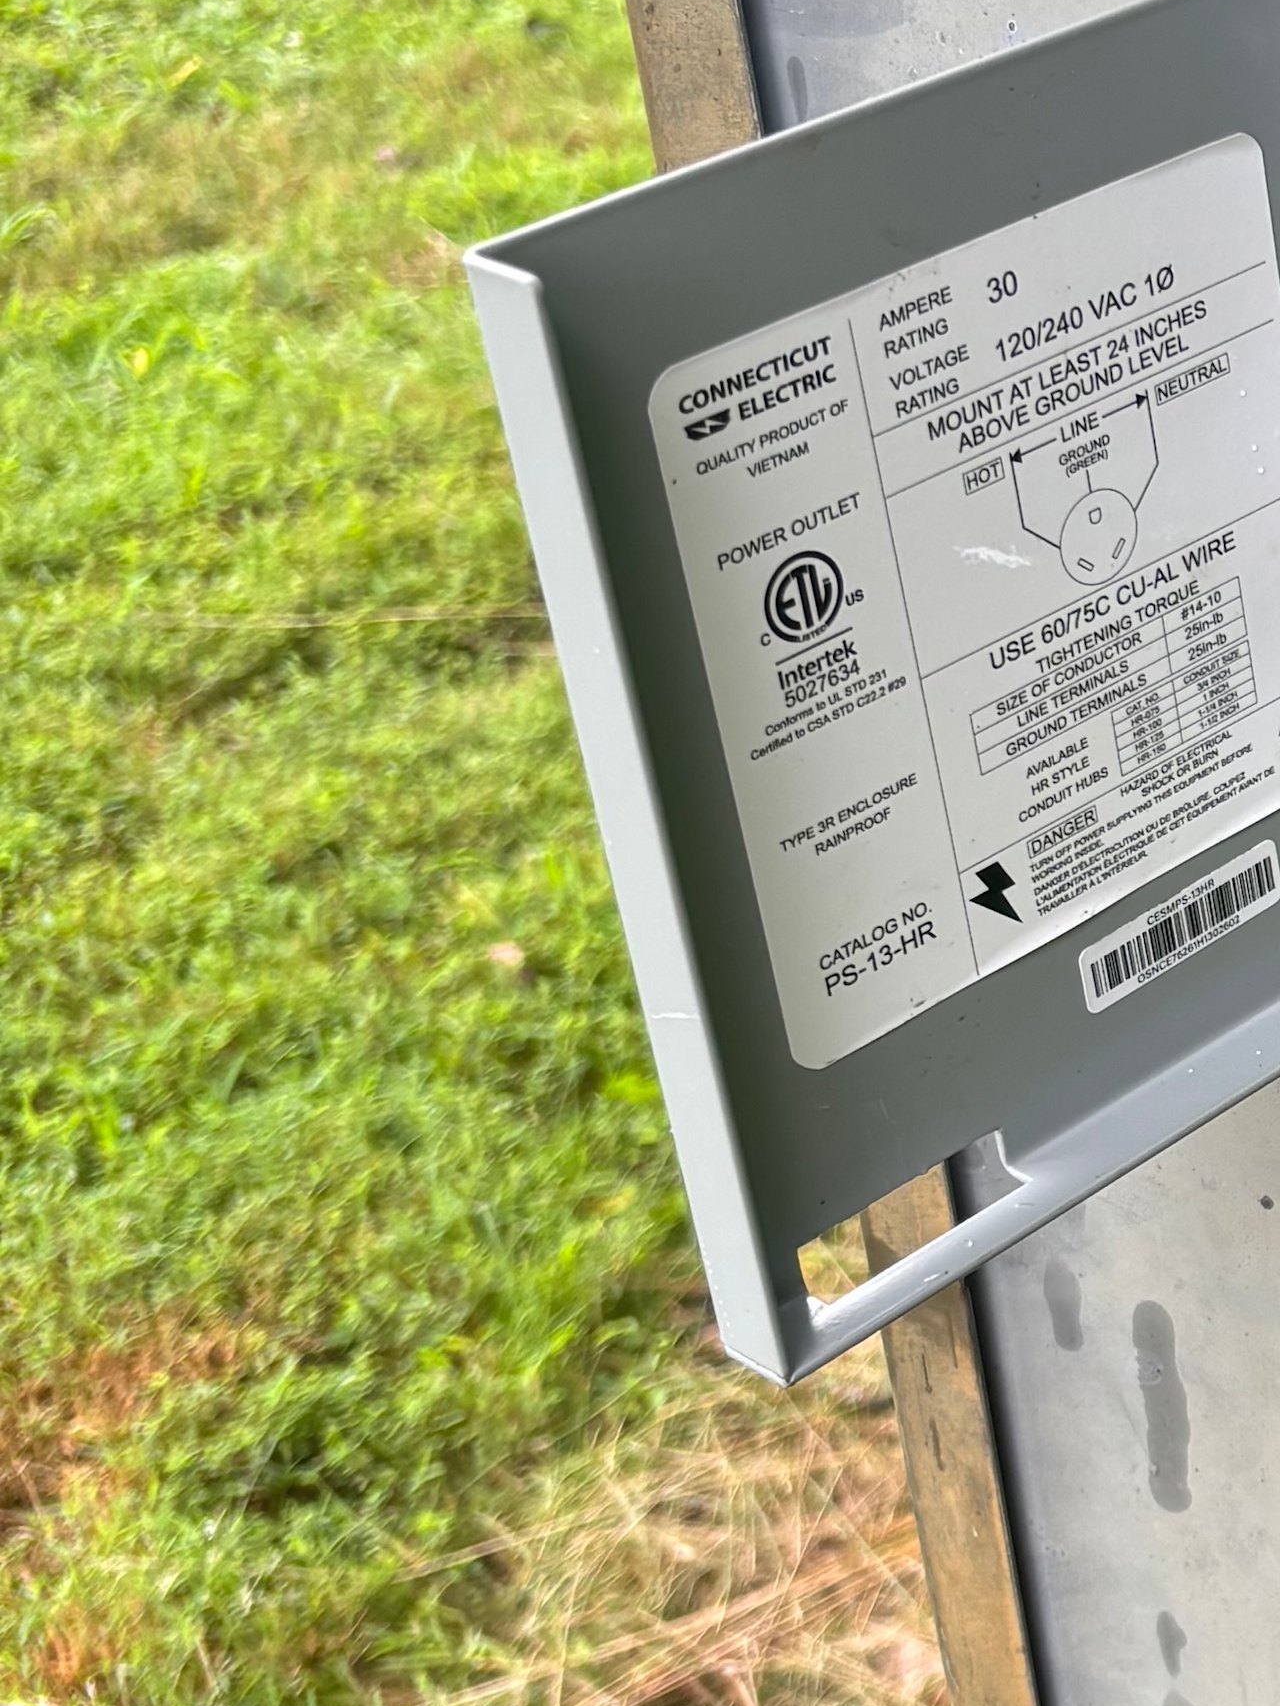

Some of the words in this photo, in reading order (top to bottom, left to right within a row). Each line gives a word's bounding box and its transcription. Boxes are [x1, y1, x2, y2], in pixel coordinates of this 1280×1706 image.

[879, 285, 952, 331] AMPERE
[986, 270, 1017, 303] 30
[883, 317, 948, 358] RATING
[995, 305, 1083, 361] 120/240
[1087, 282, 1136, 319] VAC
[678, 335, 830, 414] CONNECTICUT
[888, 343, 969, 390] VOLTAGE
[927, 388, 1003, 440] MOUNT
[1009, 375, 1032, 405] AT
[1038, 345, 1101, 390] LEAST
[1106, 334, 1129, 359] 24
[1134, 299, 1206, 347] INCHES
[1154, 357, 1227, 404] NEUTRAL
[737, 363, 836, 421] ELECTRIC
[895, 377, 959, 418] RATING
[958, 404, 1030, 453] ABOVE
[1034, 362, 1123, 415] GROUND
[1127, 334, 1189, 375] LEVEL
[695, 438, 755, 475] QUALITY
[758, 408, 825, 448] PRODUCT
[829, 398, 847, 416] OF
[1058, 434, 1110, 465] GROUND
[1059, 411, 1099, 442] LINE
[746, 441, 809, 477] VIETNAM
[966, 461, 999, 490] HOT
[1065, 448, 1108, 477] (GREEN)
[716, 526, 787, 571] POWER
[790, 491, 859, 536] OUTLET
[774, 563, 832, 641] ETL
[845, 588, 864, 606] US
[989, 631, 1036, 669] USE
[1040, 595, 1110, 643] 60/75C
[1116, 562, 1179, 605] CU-AL
[1181, 530, 1236, 571] WIRE
[760, 632, 771, 646] C
[1035, 614, 1132, 673] TIGHTENING
[1134, 579, 1199, 622] TORQUE
[777, 639, 857, 690] Intertek
[996, 689, 1028, 715] SIZE
[1031, 677, 1050, 697] OF
[1054, 631, 1142, 685] CONDUCTOR
[1180, 590, 1221, 620] #14-10
[1210, 667, 1230, 684] INCH
[764, 706, 814, 736] Conforms
[815, 700, 826, 711] to
[827, 692, 842, 705] UL
[844, 678, 866, 696] STD
[868, 668, 886, 685] 231
[784, 658, 860, 708] 5027634
[1016, 701, 1048, 727] LINE
[1050, 659, 1128, 708] TERMINALS
[1208, 681, 1229, 698] INCH
[1217, 690, 1238, 706] INCH
[750, 732, 793, 760] Certified
[794, 728, 805, 739] to
[806, 714, 831, 732] CSA
[831, 702, 854, 720] STD
[1005, 715, 1067, 755] GROUND
[1069, 673, 1146, 721] TERMINALS
[1219, 702, 1239, 718] INCH
[1026, 736, 1088, 778] AVAILABLE
[1031, 777, 1049, 795] HR
[1051, 755, 1089, 784] STYLE
[1119, 769, 1159, 797] HAZARD
[1160, 759, 1174, 774] OF
[1175, 730, 1232, 766] ELECTRICAL
[1140, 772, 1175, 796] SHOCK
[1176, 763, 1191, 777] OR
[1191, 747, 1218, 769] BURN
[778, 825, 815, 851] TYPE
[817, 816, 835, 833] 3R
[837, 772, 917, 823] ENCLOSURE
[1018, 784, 1072, 822] CONDUIT
[1075, 766, 1108, 792] HUBS
[1029, 854, 1054, 872] TURN
[1054, 843, 1072, 858] OFF
[1073, 825, 1105, 848] POWER
[1106, 799, 1152, 830] SUPPLYING
[1153, 787, 1172, 803] THIS
[1220, 743, 1252, 767] BEFORE
[1155, 826, 1168, 838] DE
[1238, 772, 1262, 792] AVANT
[1263, 765, 1275, 777] DE
[814, 806, 890, 856] RAINPROOF
[1030, 809, 1096, 855] DANGER
[1033, 870, 1070, 896] DANGER
[1145, 820, 1158, 833] OU
[1158, 813, 1171, 825] DE
[1212, 771, 1245, 795] COUPEZ
[1146, 878, 1214, 925] CESMPS-13HR
[819, 917, 898, 970] CATALOG
[901, 902, 932, 925] NO.
[824, 920, 936, 996] PS-13-HR
